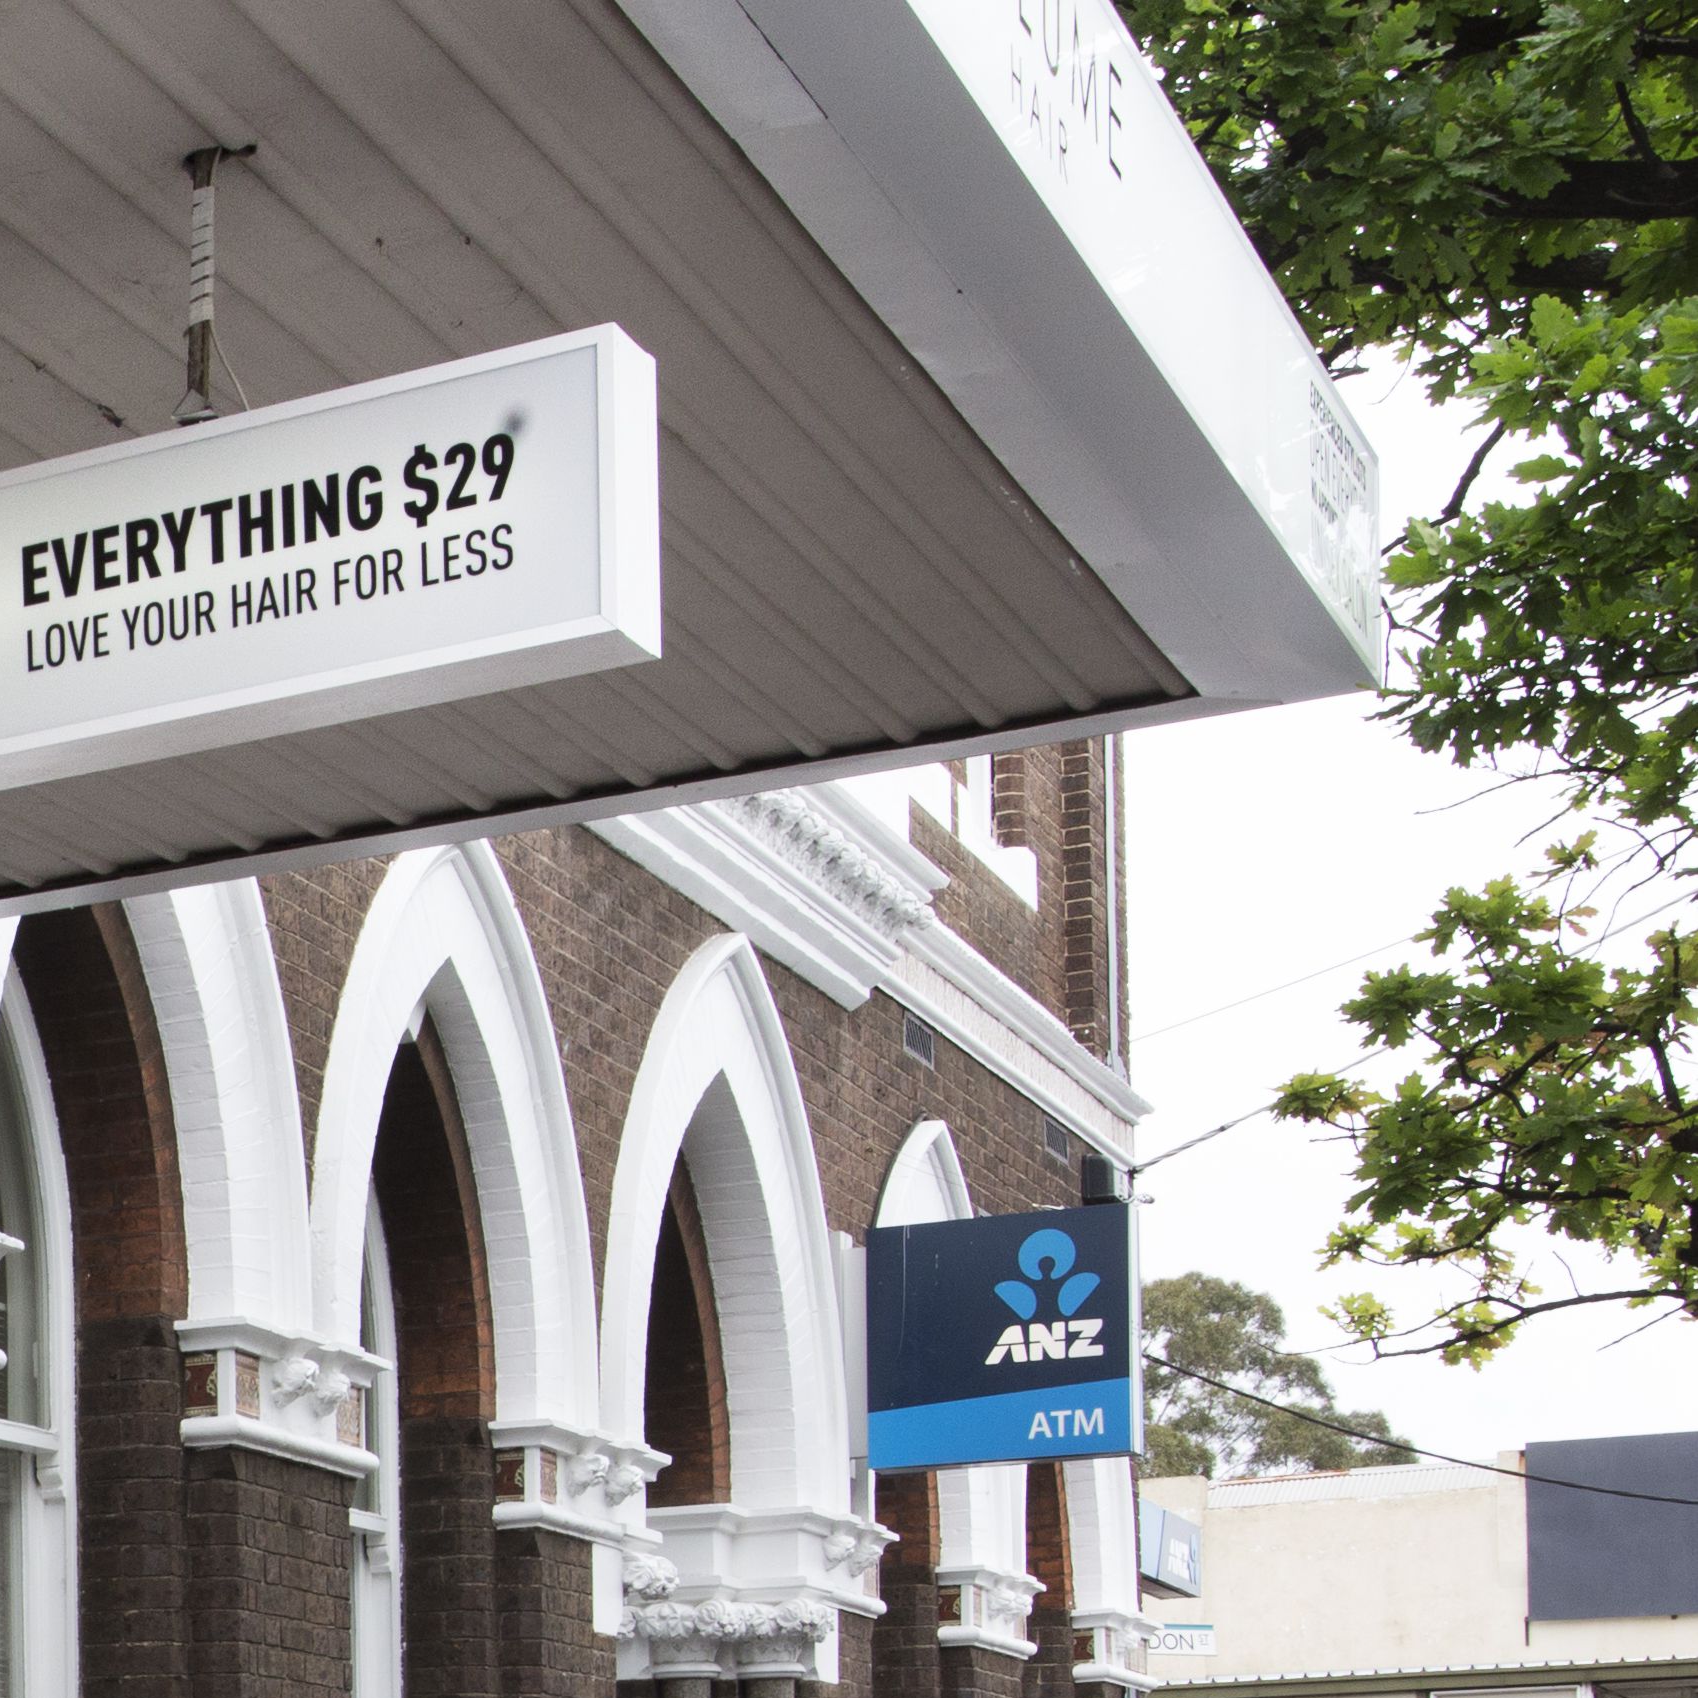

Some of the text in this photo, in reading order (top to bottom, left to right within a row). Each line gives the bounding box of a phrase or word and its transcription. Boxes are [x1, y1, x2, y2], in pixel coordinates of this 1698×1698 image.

[1010, 43, 1069, 185] HAIR
[21, 432, 516, 607] EVERYTHING $29
[25, 523, 515, 672] LOVE YOUR HAIR FOR LESS
[984, 1318, 1104, 1366] ANZ
[1028, 1407, 1105, 1440] ATM
[1149, 1632, 1194, 1651] DON
